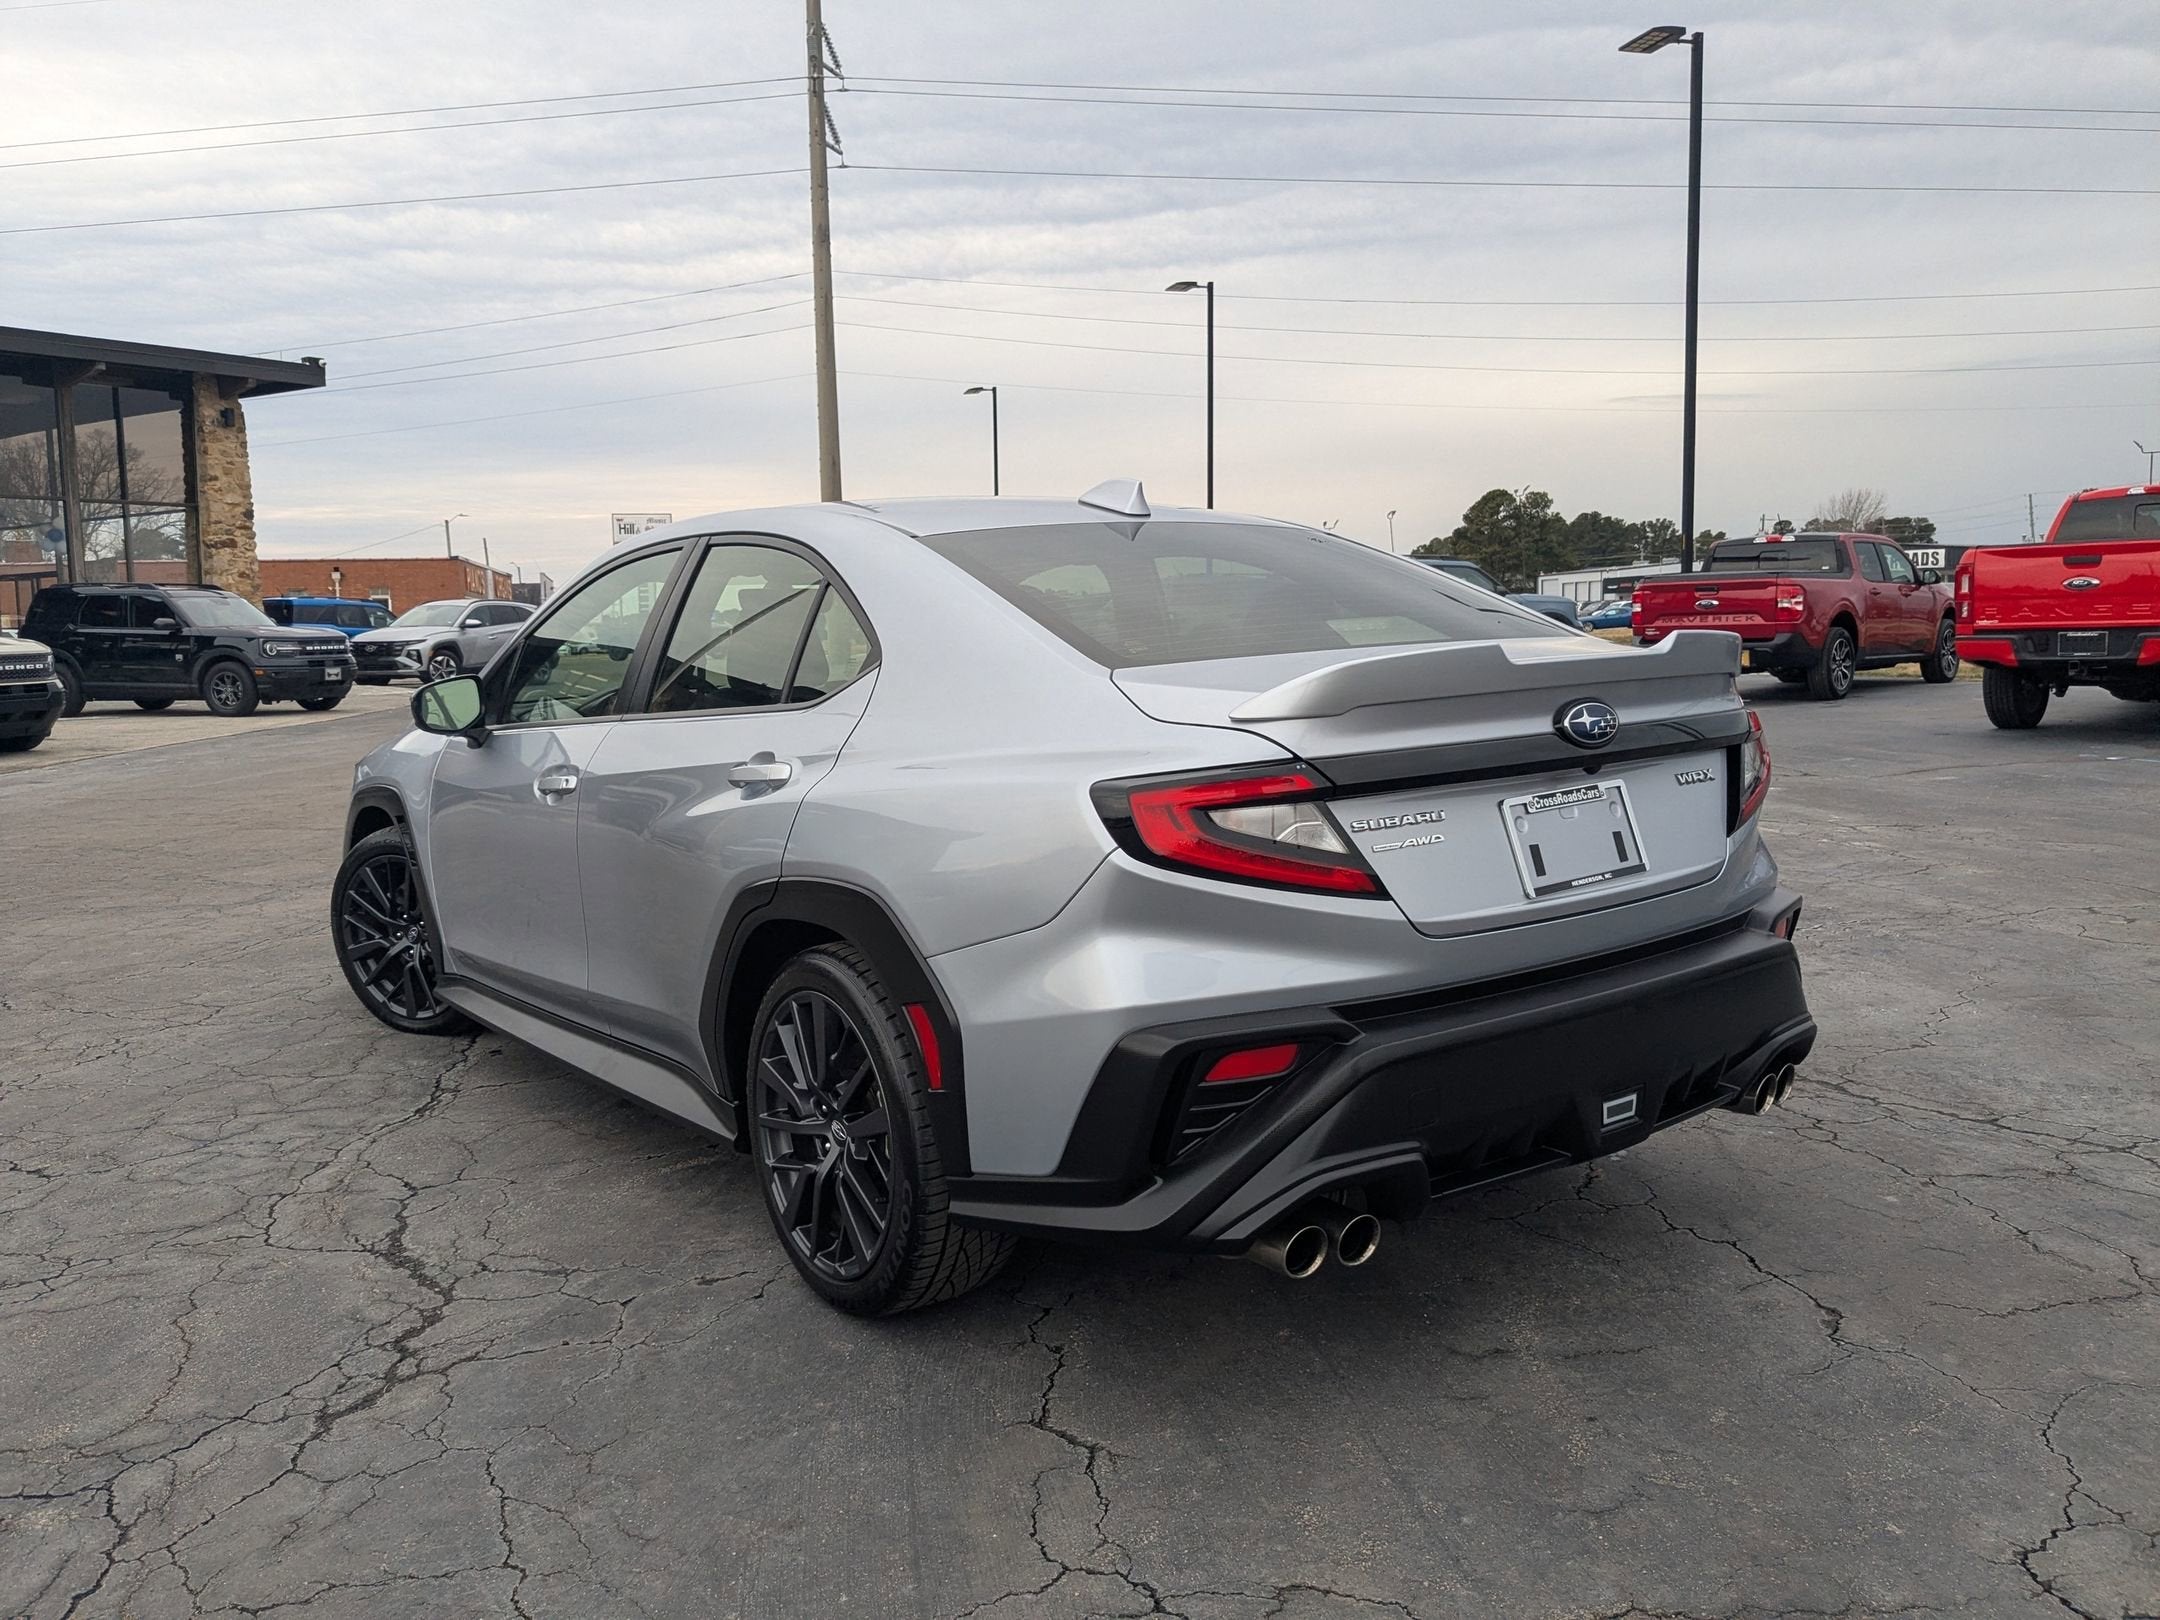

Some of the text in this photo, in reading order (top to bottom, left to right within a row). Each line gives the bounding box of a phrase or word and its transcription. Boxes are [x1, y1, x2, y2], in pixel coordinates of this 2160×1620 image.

[618, 523, 635, 535] Hill
[1661, 615, 1756, 625] MAVERICK
[1674, 768, 1715, 786] WRX
[1350, 809, 1446, 833] SUBARU
[1401, 834, 1445, 849] AWD
